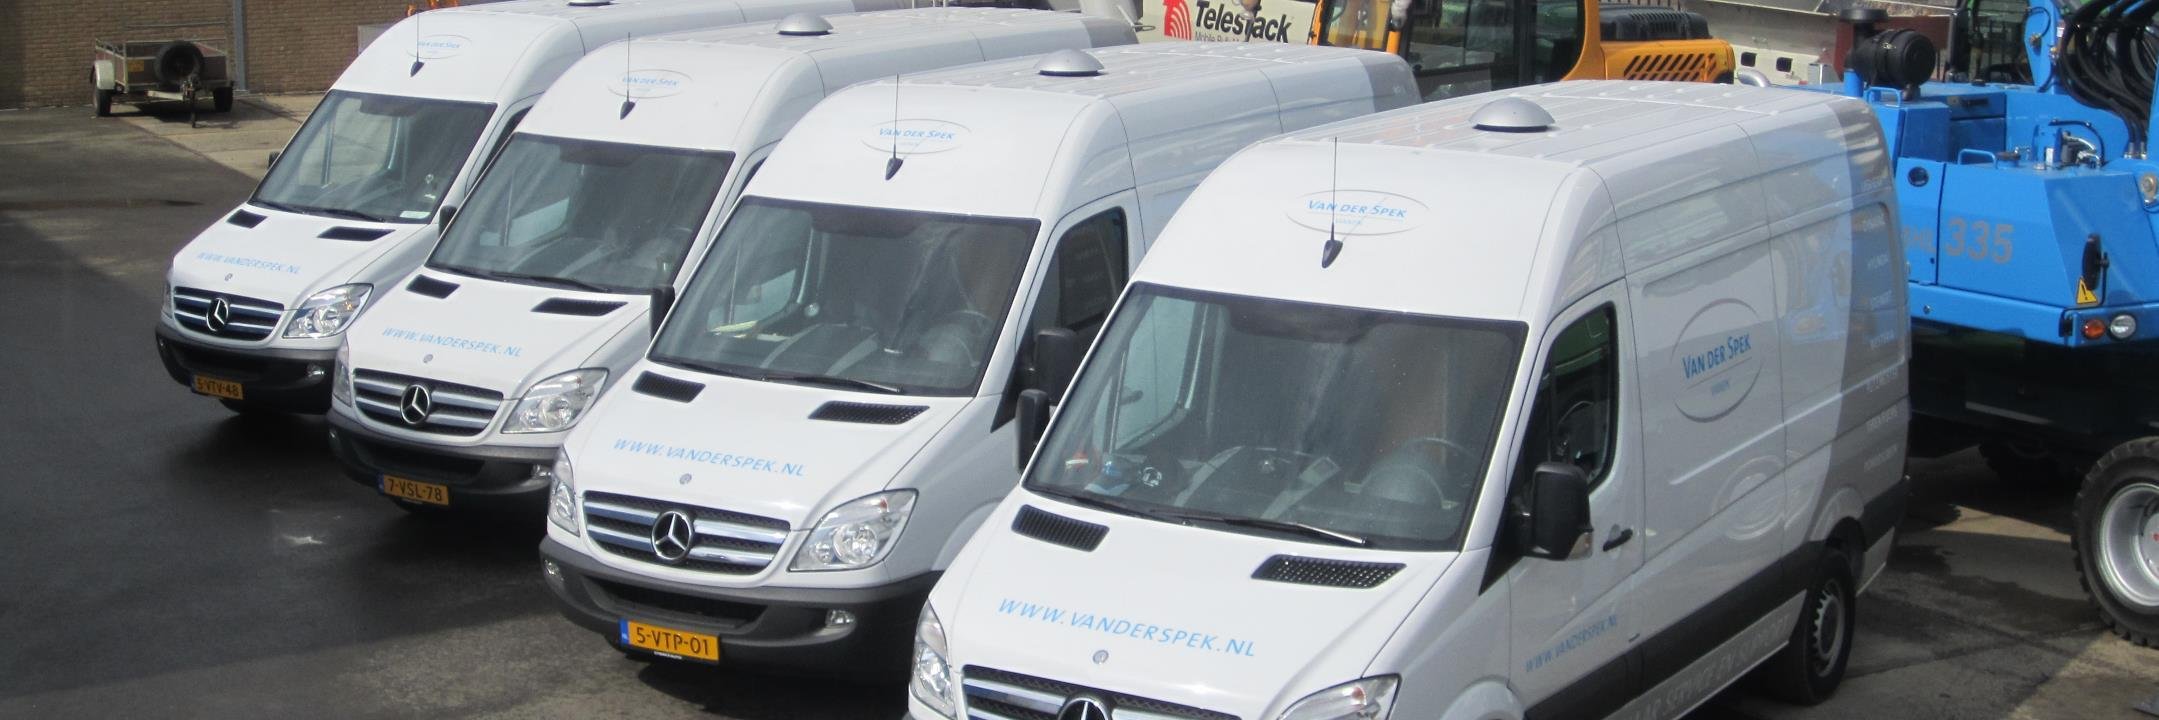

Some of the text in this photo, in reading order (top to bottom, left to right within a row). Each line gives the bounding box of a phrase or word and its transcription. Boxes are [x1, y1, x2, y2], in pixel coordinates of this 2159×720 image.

[1307, 199, 1336, 210] VAN
[1340, 203, 1367, 214] DER
[1945, 215, 2014, 264] 335
[197, 251, 301, 275] WWW.VANDERSPEK.NL
[382, 326, 523, 358] WWW.VANDERSPEK.NL
[1682, 333, 1752, 379] VAN DER SPEK
[613, 437, 806, 477] WWW.VANDERSPEK.NL
[387, 477, 442, 502] 7-VSL-78
[636, 626, 709, 656] 5-VTP-01
[997, 598, 1256, 657] WWW.VANDERSPEK.NL
